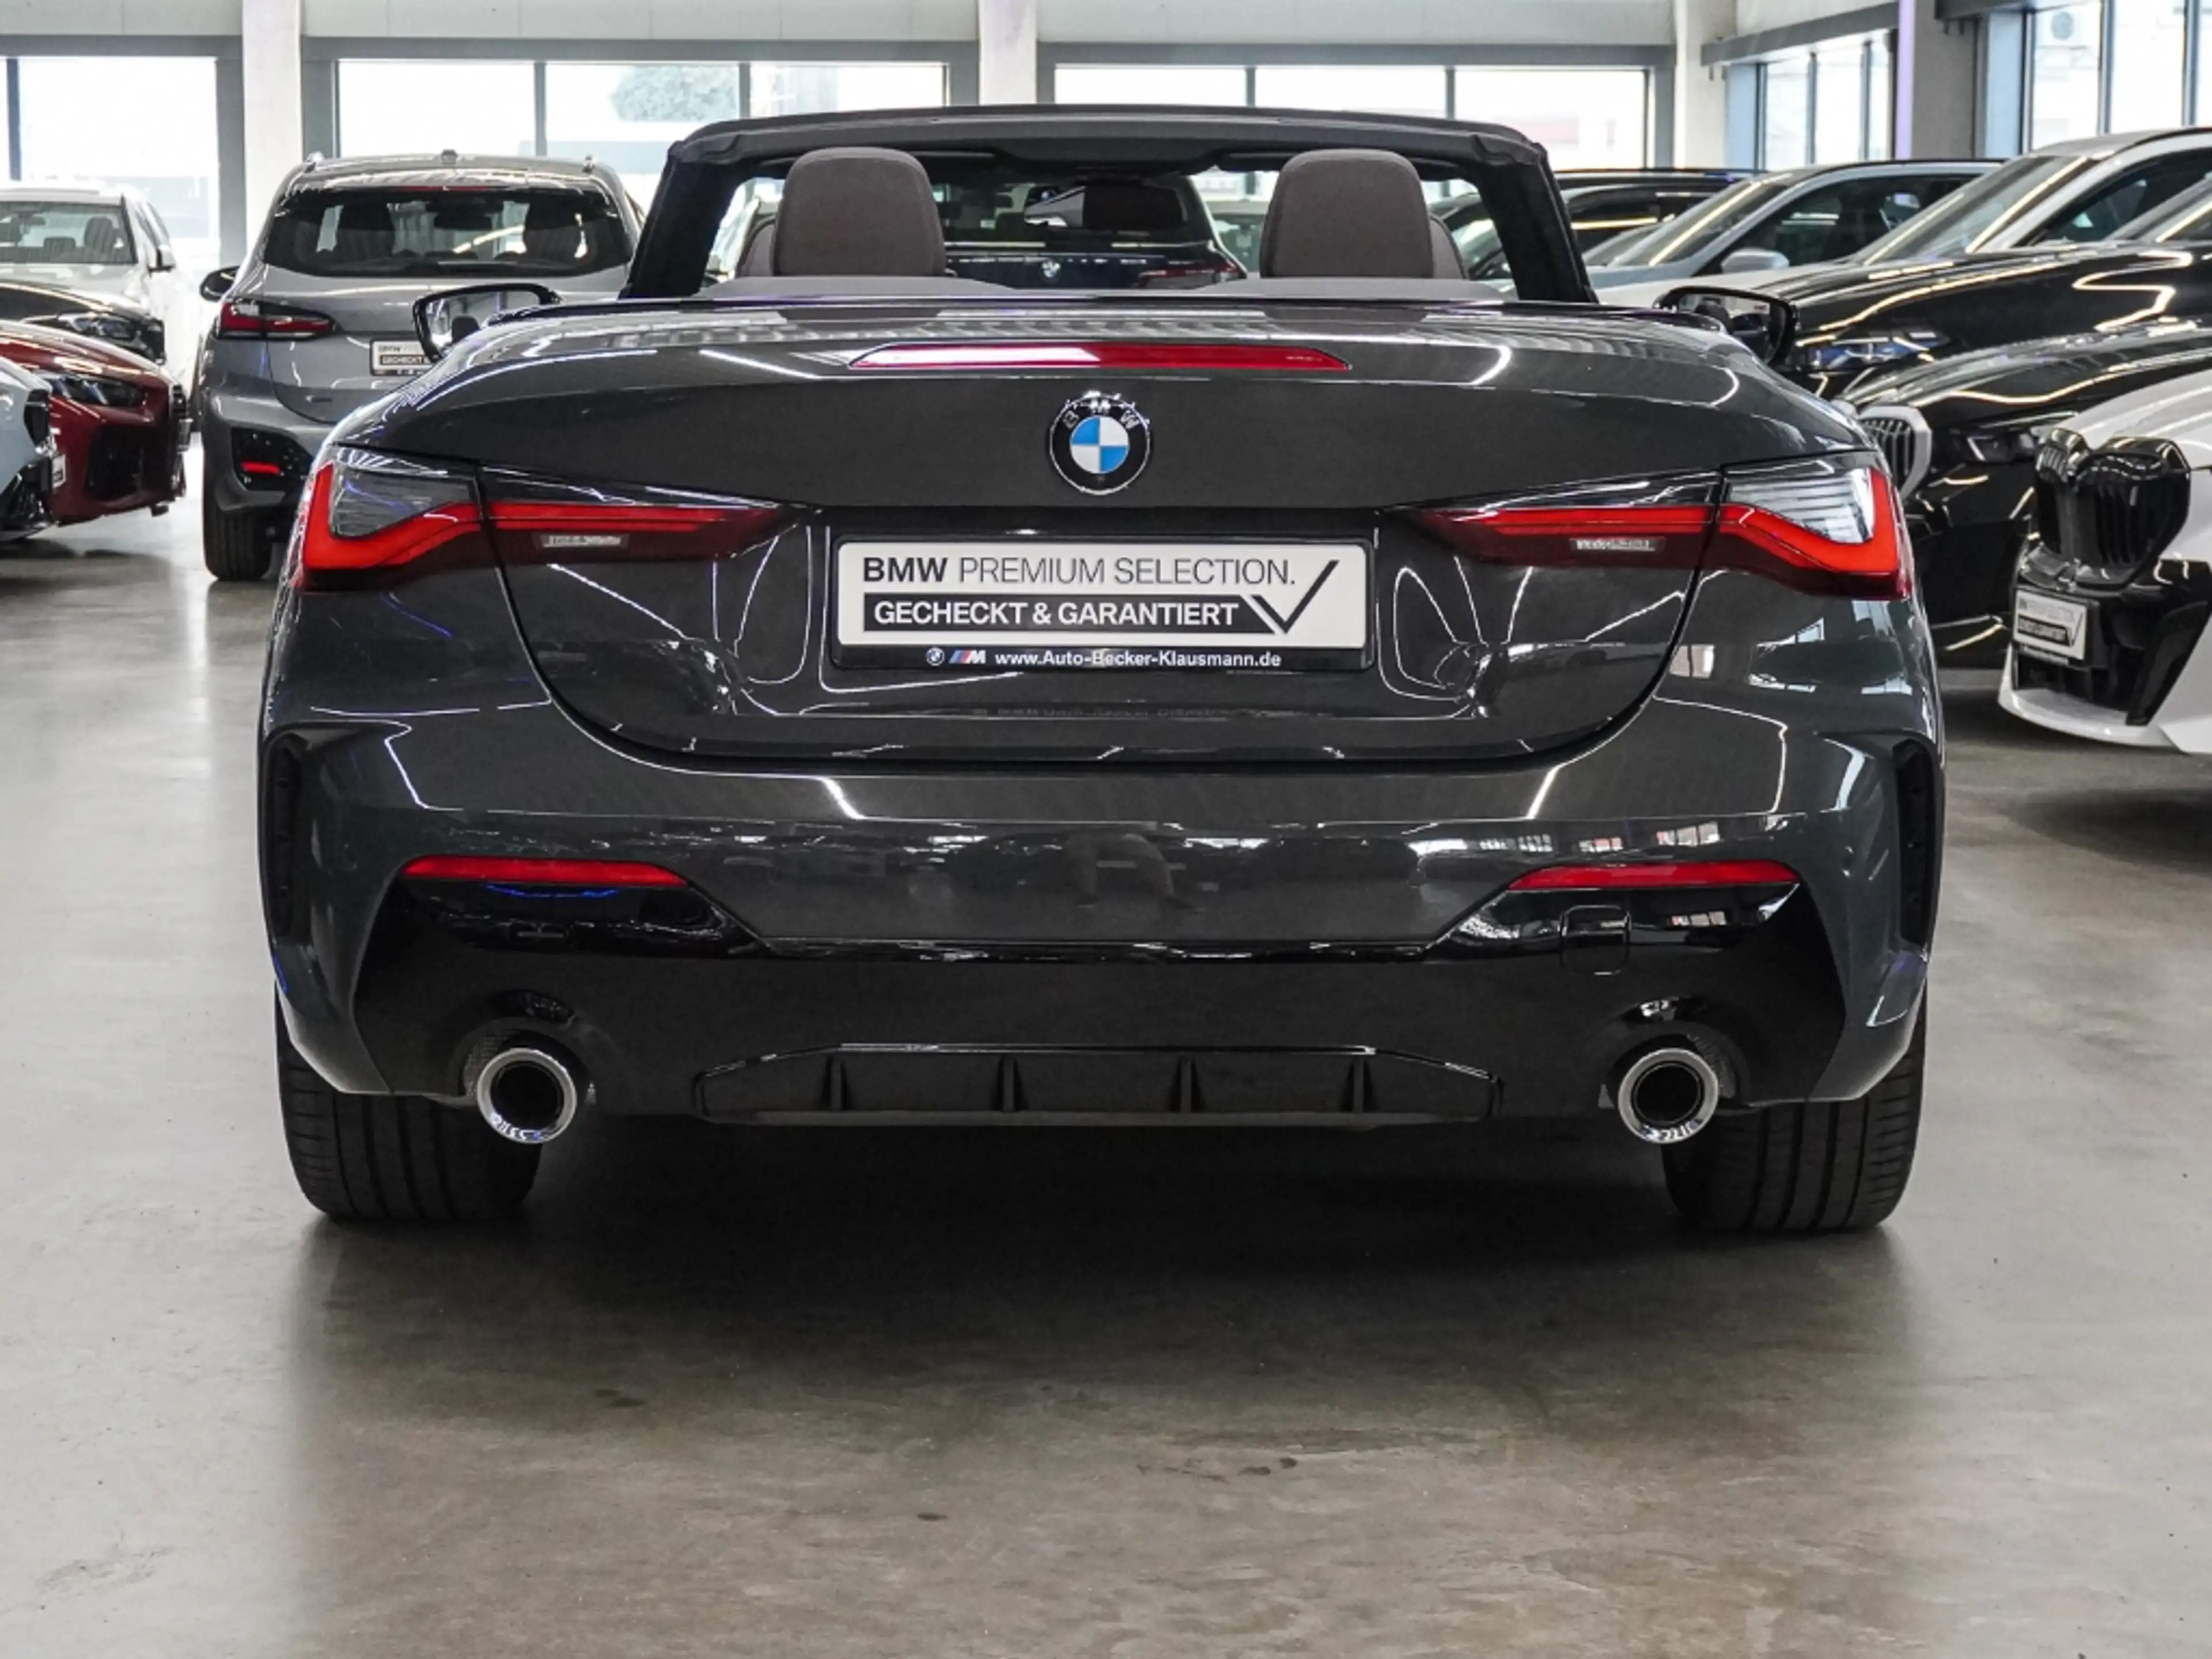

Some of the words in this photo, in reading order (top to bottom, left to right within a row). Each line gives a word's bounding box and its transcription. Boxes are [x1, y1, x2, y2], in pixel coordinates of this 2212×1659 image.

[863, 557, 948, 582] BMW
[960, 557, 1105, 584] PREMIUM
[1114, 557, 1296, 585] SELECTION.
[874, 601, 1028, 624] GECHECKT
[1032, 603, 1051, 624] &
[1058, 603, 1240, 626] GARANTIERT
[995, 650, 1282, 666] www.Auto-Becker-Klausmann.de
